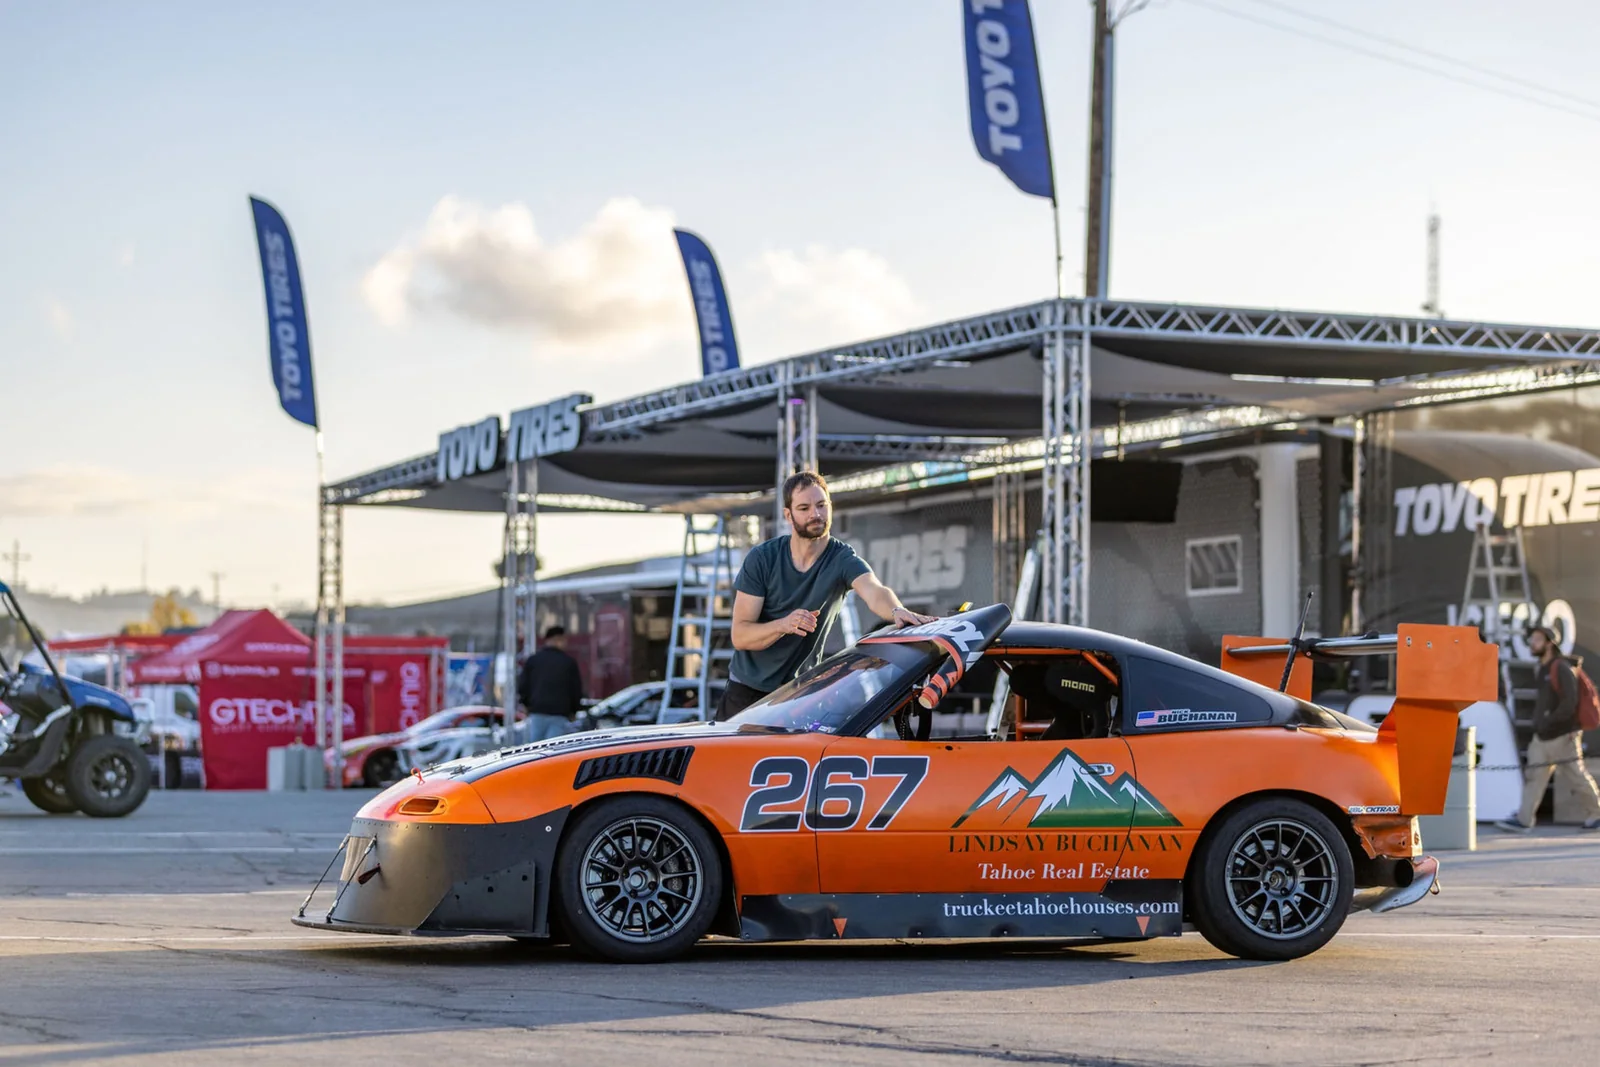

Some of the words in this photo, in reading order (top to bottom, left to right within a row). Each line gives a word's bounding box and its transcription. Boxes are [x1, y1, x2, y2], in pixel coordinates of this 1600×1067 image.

[976, 19, 1022, 156] TOYO
[263, 228, 294, 319] TIRES
[275, 319, 303, 403] TOYO
[436, 416, 500, 483] TOYO
[506, 394, 583, 463] TIRES
[1393, 477, 1499, 537] TOYO
[1157, 711, 1236, 723] BUCHANAN
[739, 755, 930, 833] 267
[949, 834, 1048, 853] LINDSAY
[1056, 834, 1184, 852] BUCHANAN
[978, 862, 1036, 880] Tahoe
[1041, 862, 1083, 880] Real
[1090, 861, 1150, 880] Estate
[943, 896, 1181, 917] truckeetahoehouses.com
